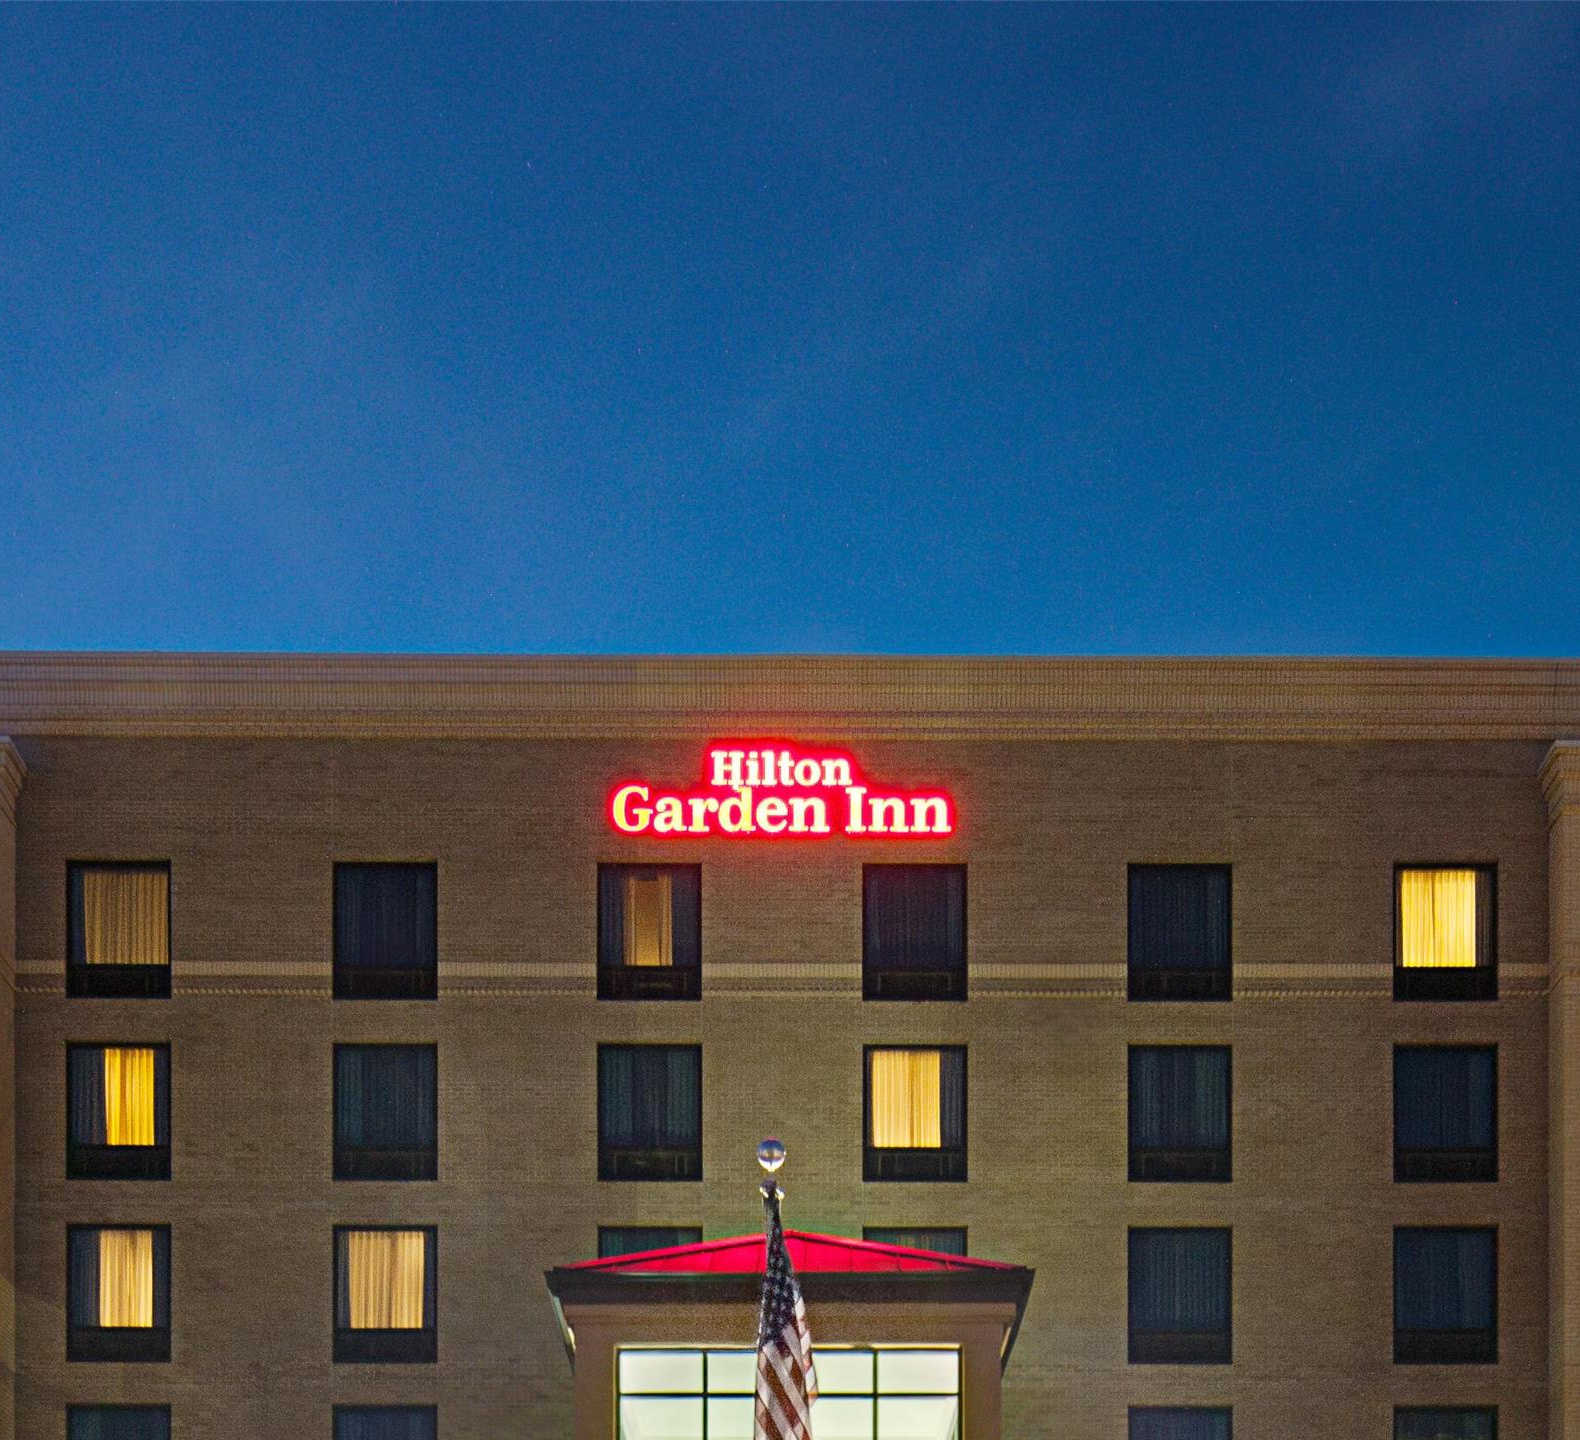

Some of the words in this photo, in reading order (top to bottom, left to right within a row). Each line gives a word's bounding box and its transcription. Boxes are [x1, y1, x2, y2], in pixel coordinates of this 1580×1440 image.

[710, 750, 853, 787] Hilton
[612, 785, 831, 834] Garden
[844, 786, 952, 834] Inn
